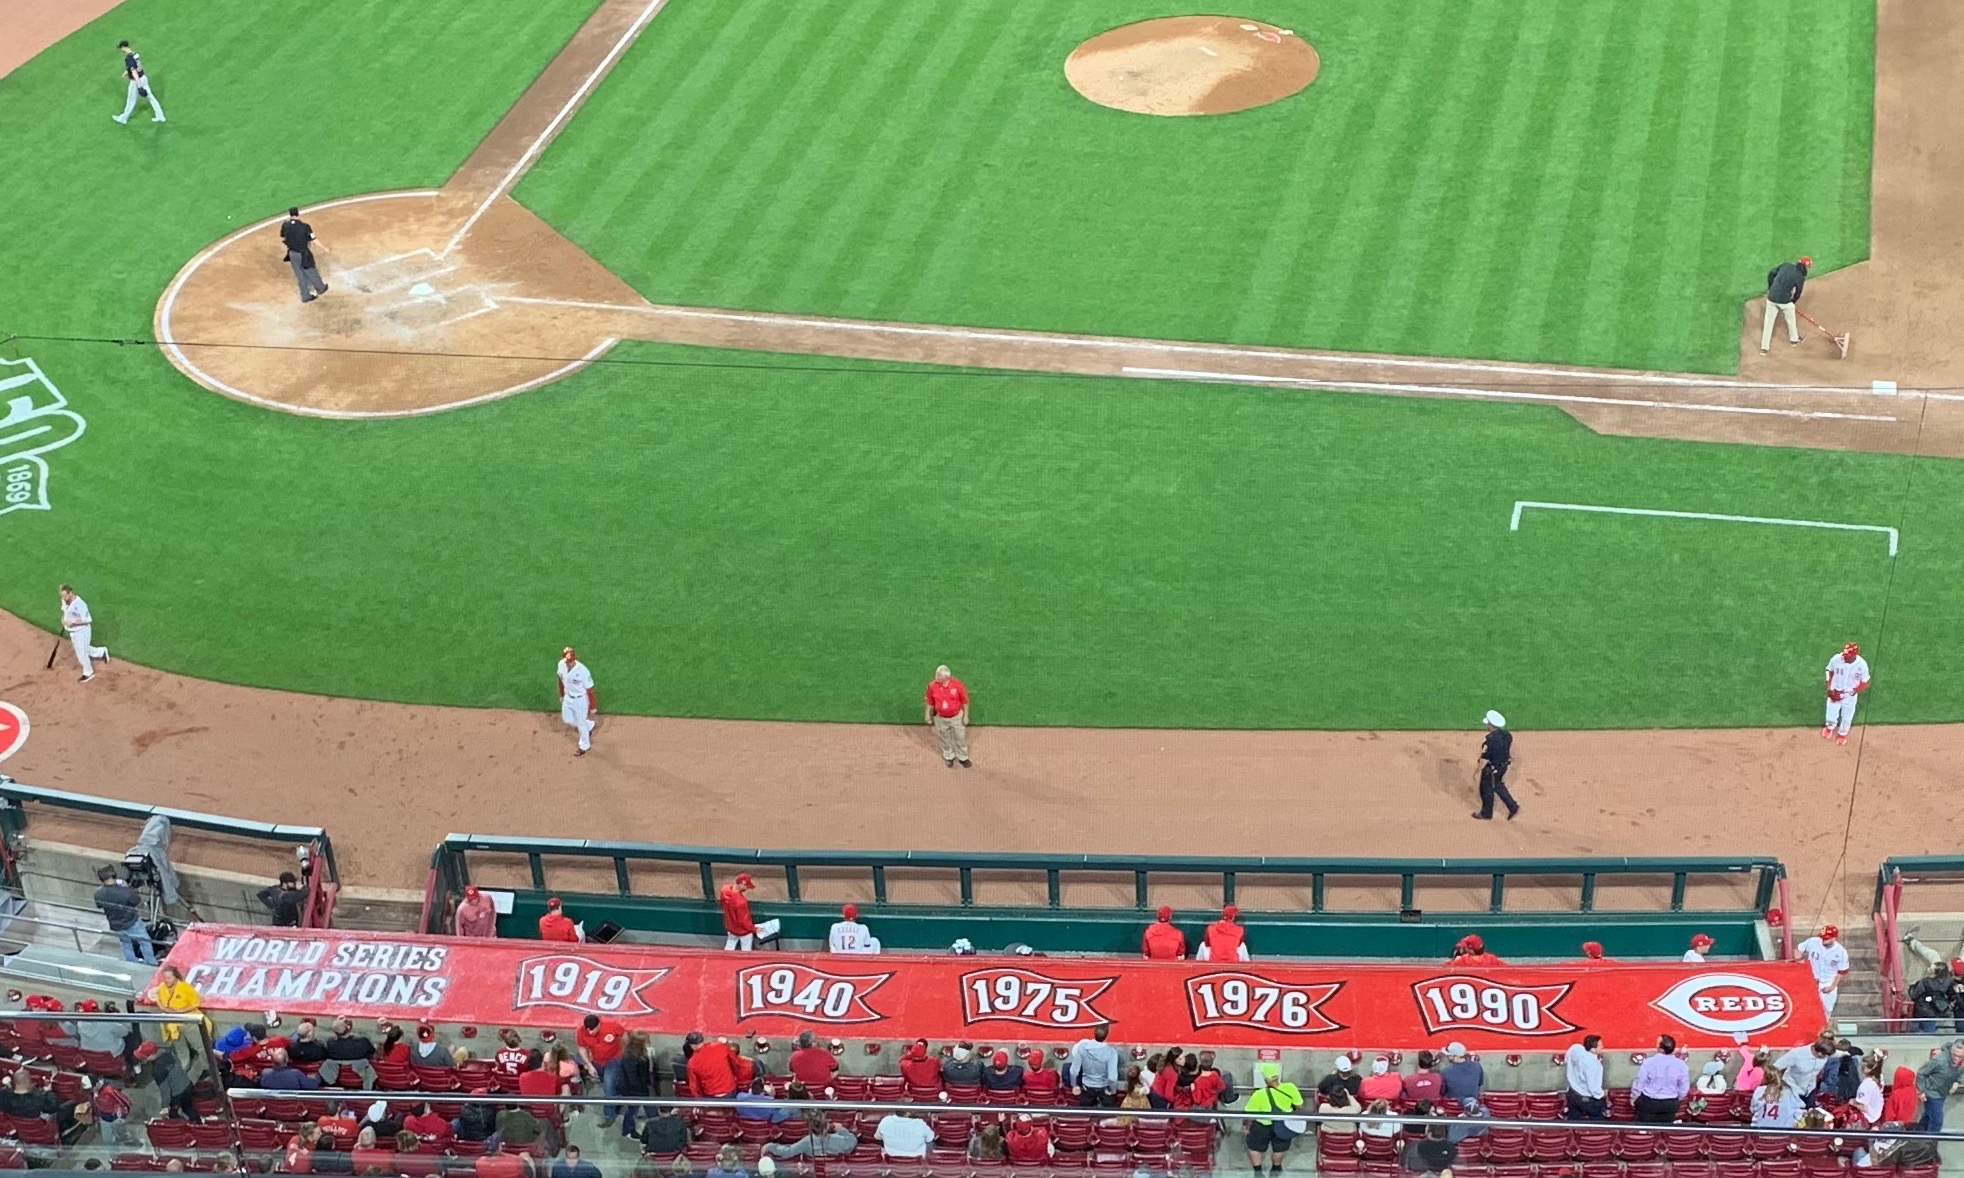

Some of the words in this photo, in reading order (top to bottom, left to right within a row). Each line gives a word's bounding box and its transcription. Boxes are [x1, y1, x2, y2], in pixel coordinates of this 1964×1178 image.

[6, 463, 33, 503] 1869
[215, 936, 327, 965] WORLD
[332, 941, 447, 971] SERIES
[841, 935, 856, 950] 12
[185, 963, 447, 1007] CHAMPIONS
[529, 961, 632, 1010] 1919
[747, 968, 855, 1018] 1940
[971, 974, 1082, 1023] 1975
[1197, 979, 1310, 1028] 1976
[1694, 995, 1785, 1012] REDS
[1425, 982, 1540, 1030] 1990
[498, 1051, 527, 1063] BENCH
[506, 1062, 518, 1075] 5
[1761, 1105, 1779, 1121] 14
[288, 1152, 297, 1166] 4
